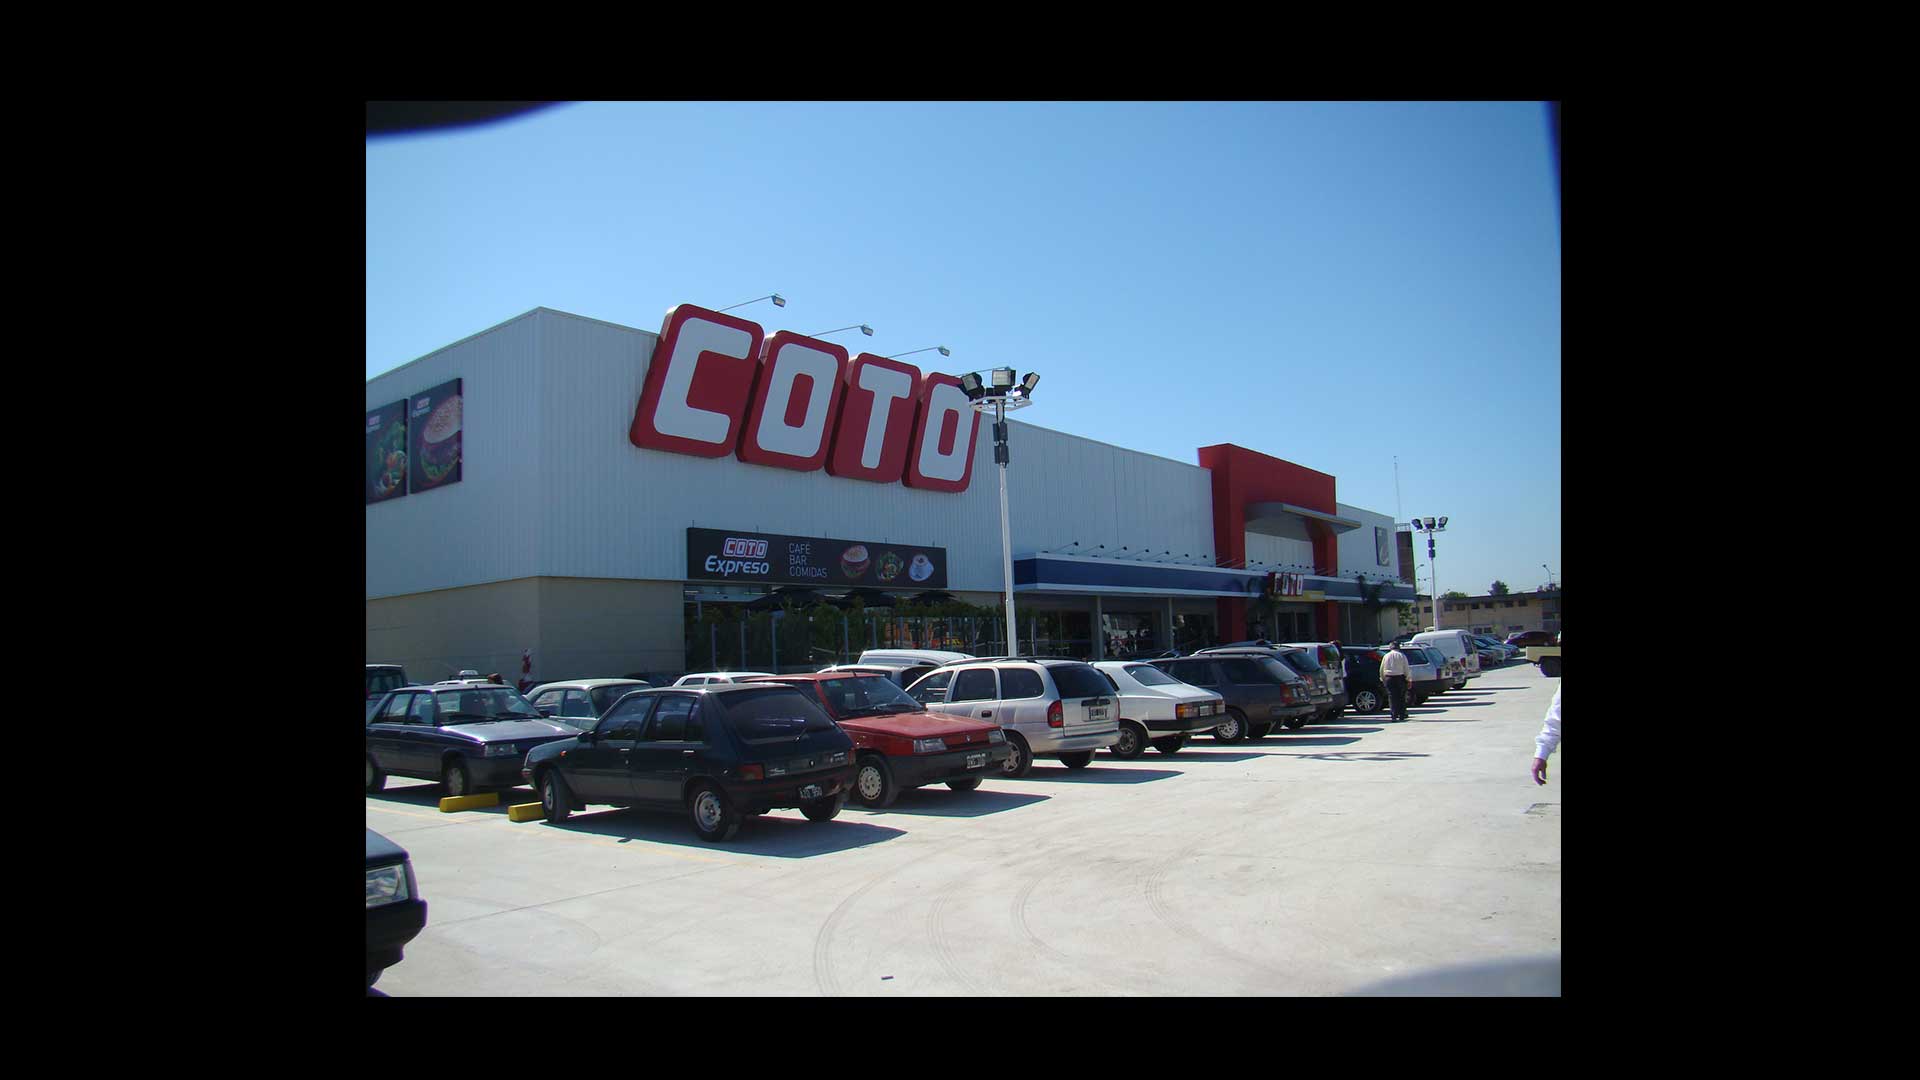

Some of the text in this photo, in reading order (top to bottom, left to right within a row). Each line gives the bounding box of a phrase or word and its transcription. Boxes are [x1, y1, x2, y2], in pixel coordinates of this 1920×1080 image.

[653, 316, 977, 482] COTO
[724, 538, 767, 558] COTO
[789, 542, 811, 554] CAFÉ
[705, 555, 769, 576] Expreso
[789, 555, 807, 566] BAR
[789, 566, 828, 578] COMIDAS
[1274, 573, 1303, 595] COTO
